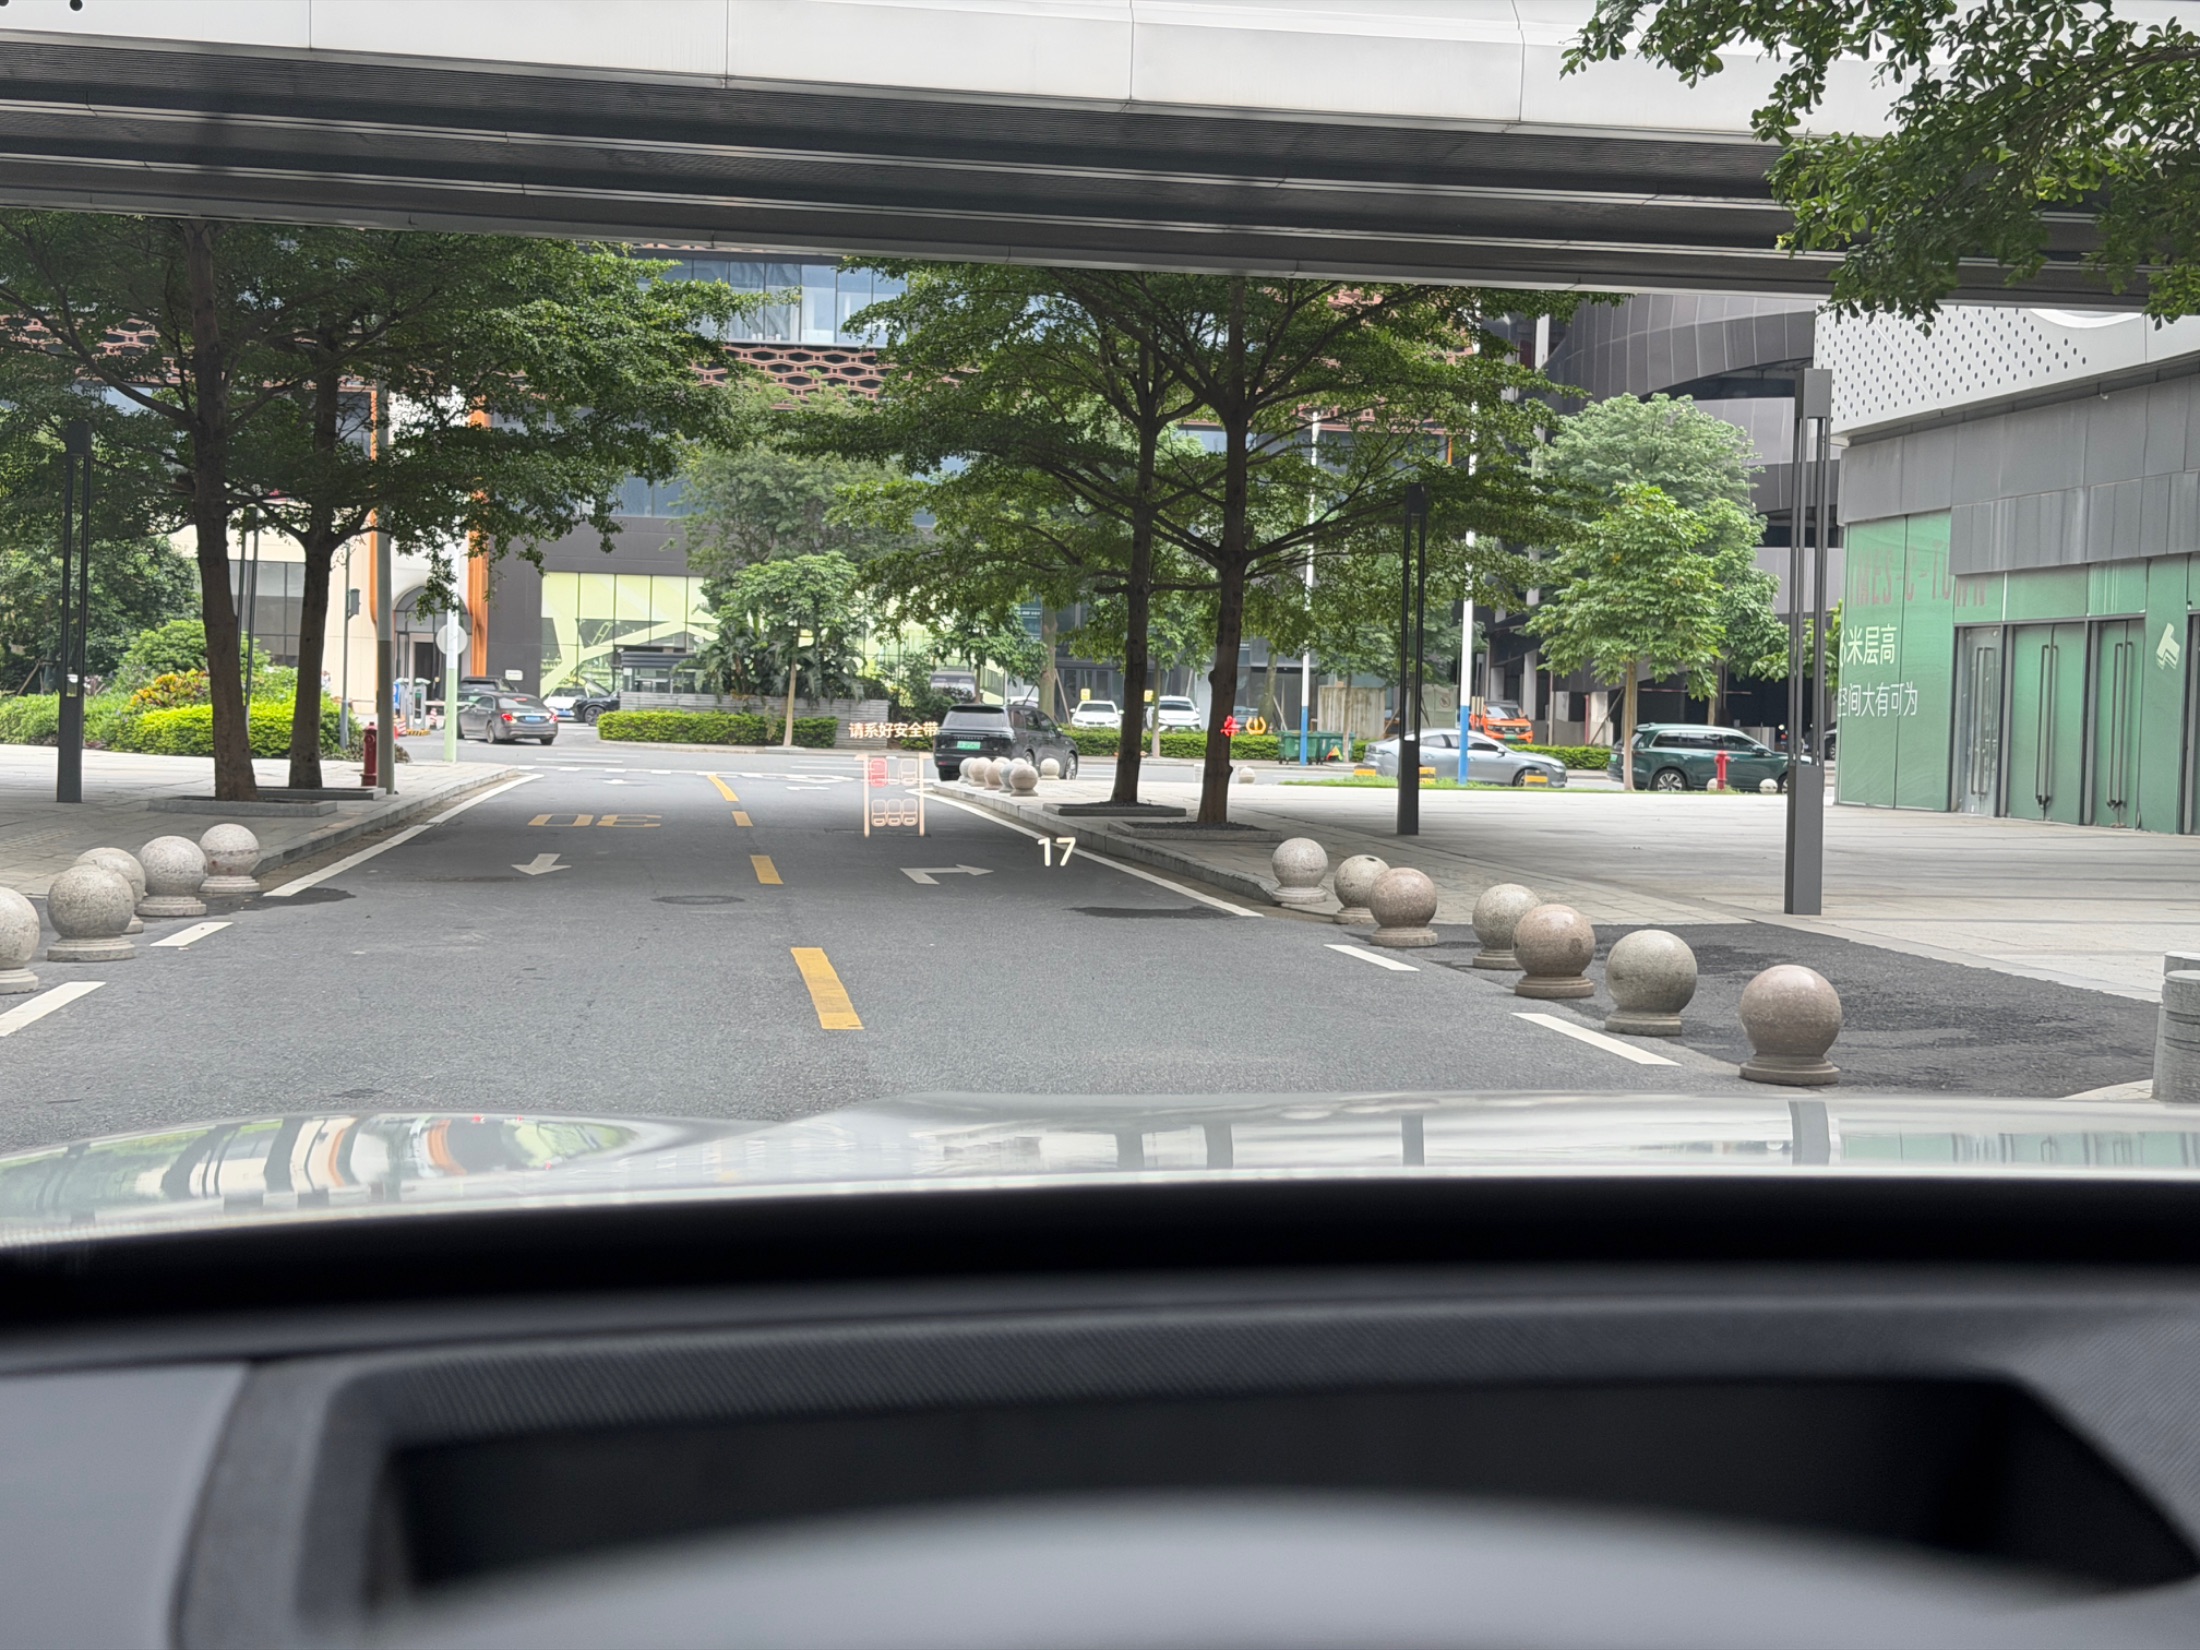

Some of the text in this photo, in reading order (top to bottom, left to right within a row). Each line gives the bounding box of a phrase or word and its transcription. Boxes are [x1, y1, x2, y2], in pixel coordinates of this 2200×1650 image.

[848, 721, 938, 739] 请系好安全带
[1037, 836, 1076, 867] 17
